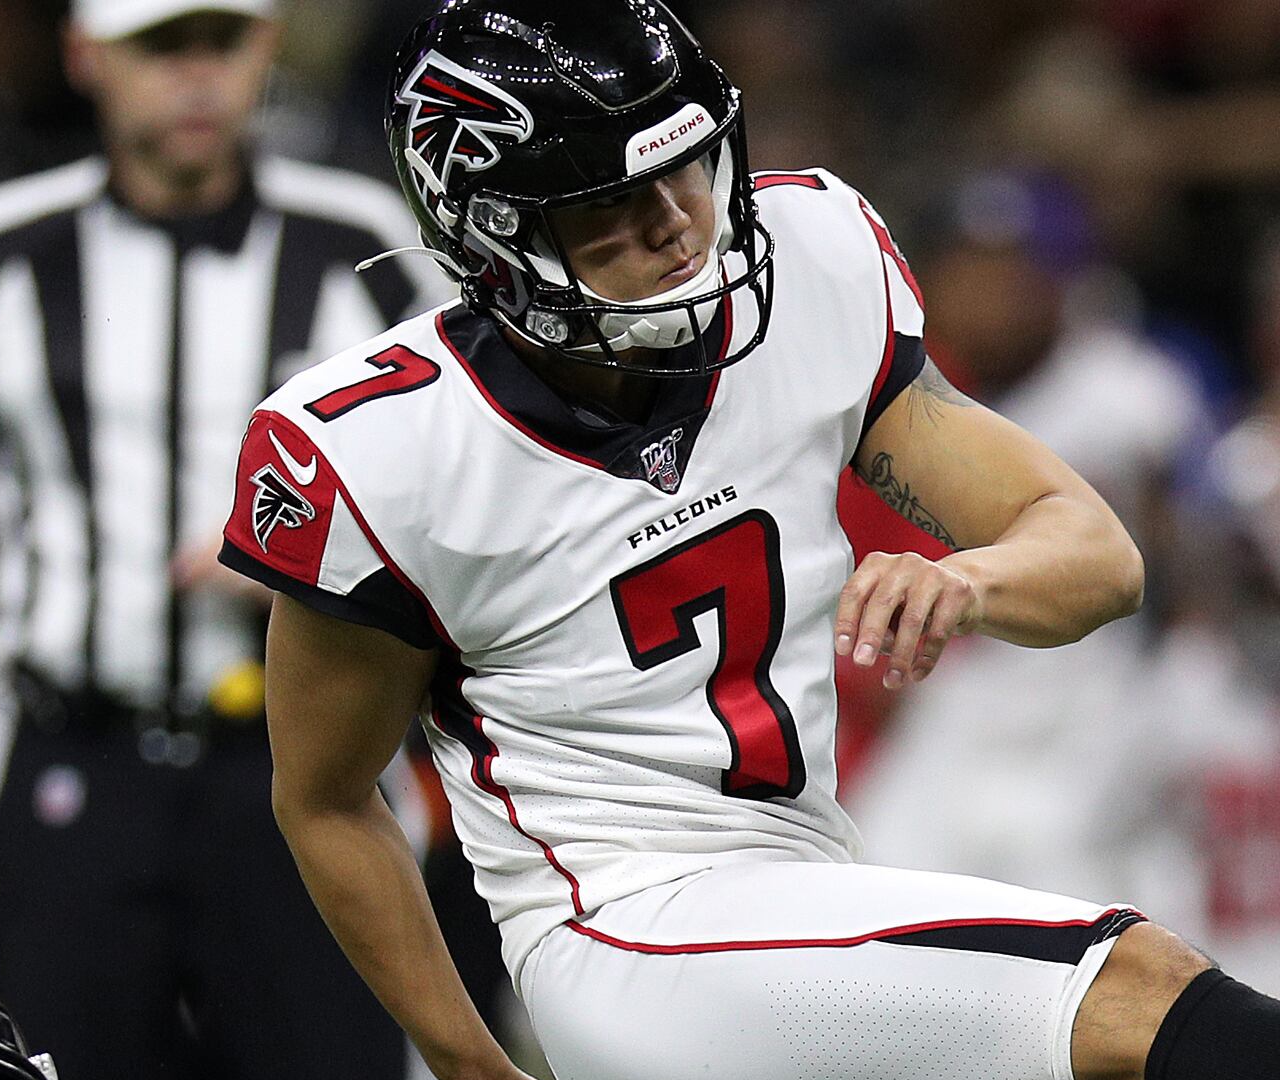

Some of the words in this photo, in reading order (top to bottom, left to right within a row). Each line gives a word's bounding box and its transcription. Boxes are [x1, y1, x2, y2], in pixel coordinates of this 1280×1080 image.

[637, 113, 705, 156] FALCONS
[303, 343, 441, 423] 7
[627, 485, 737, 549] FALCONS
[609, 508, 807, 799] 7
